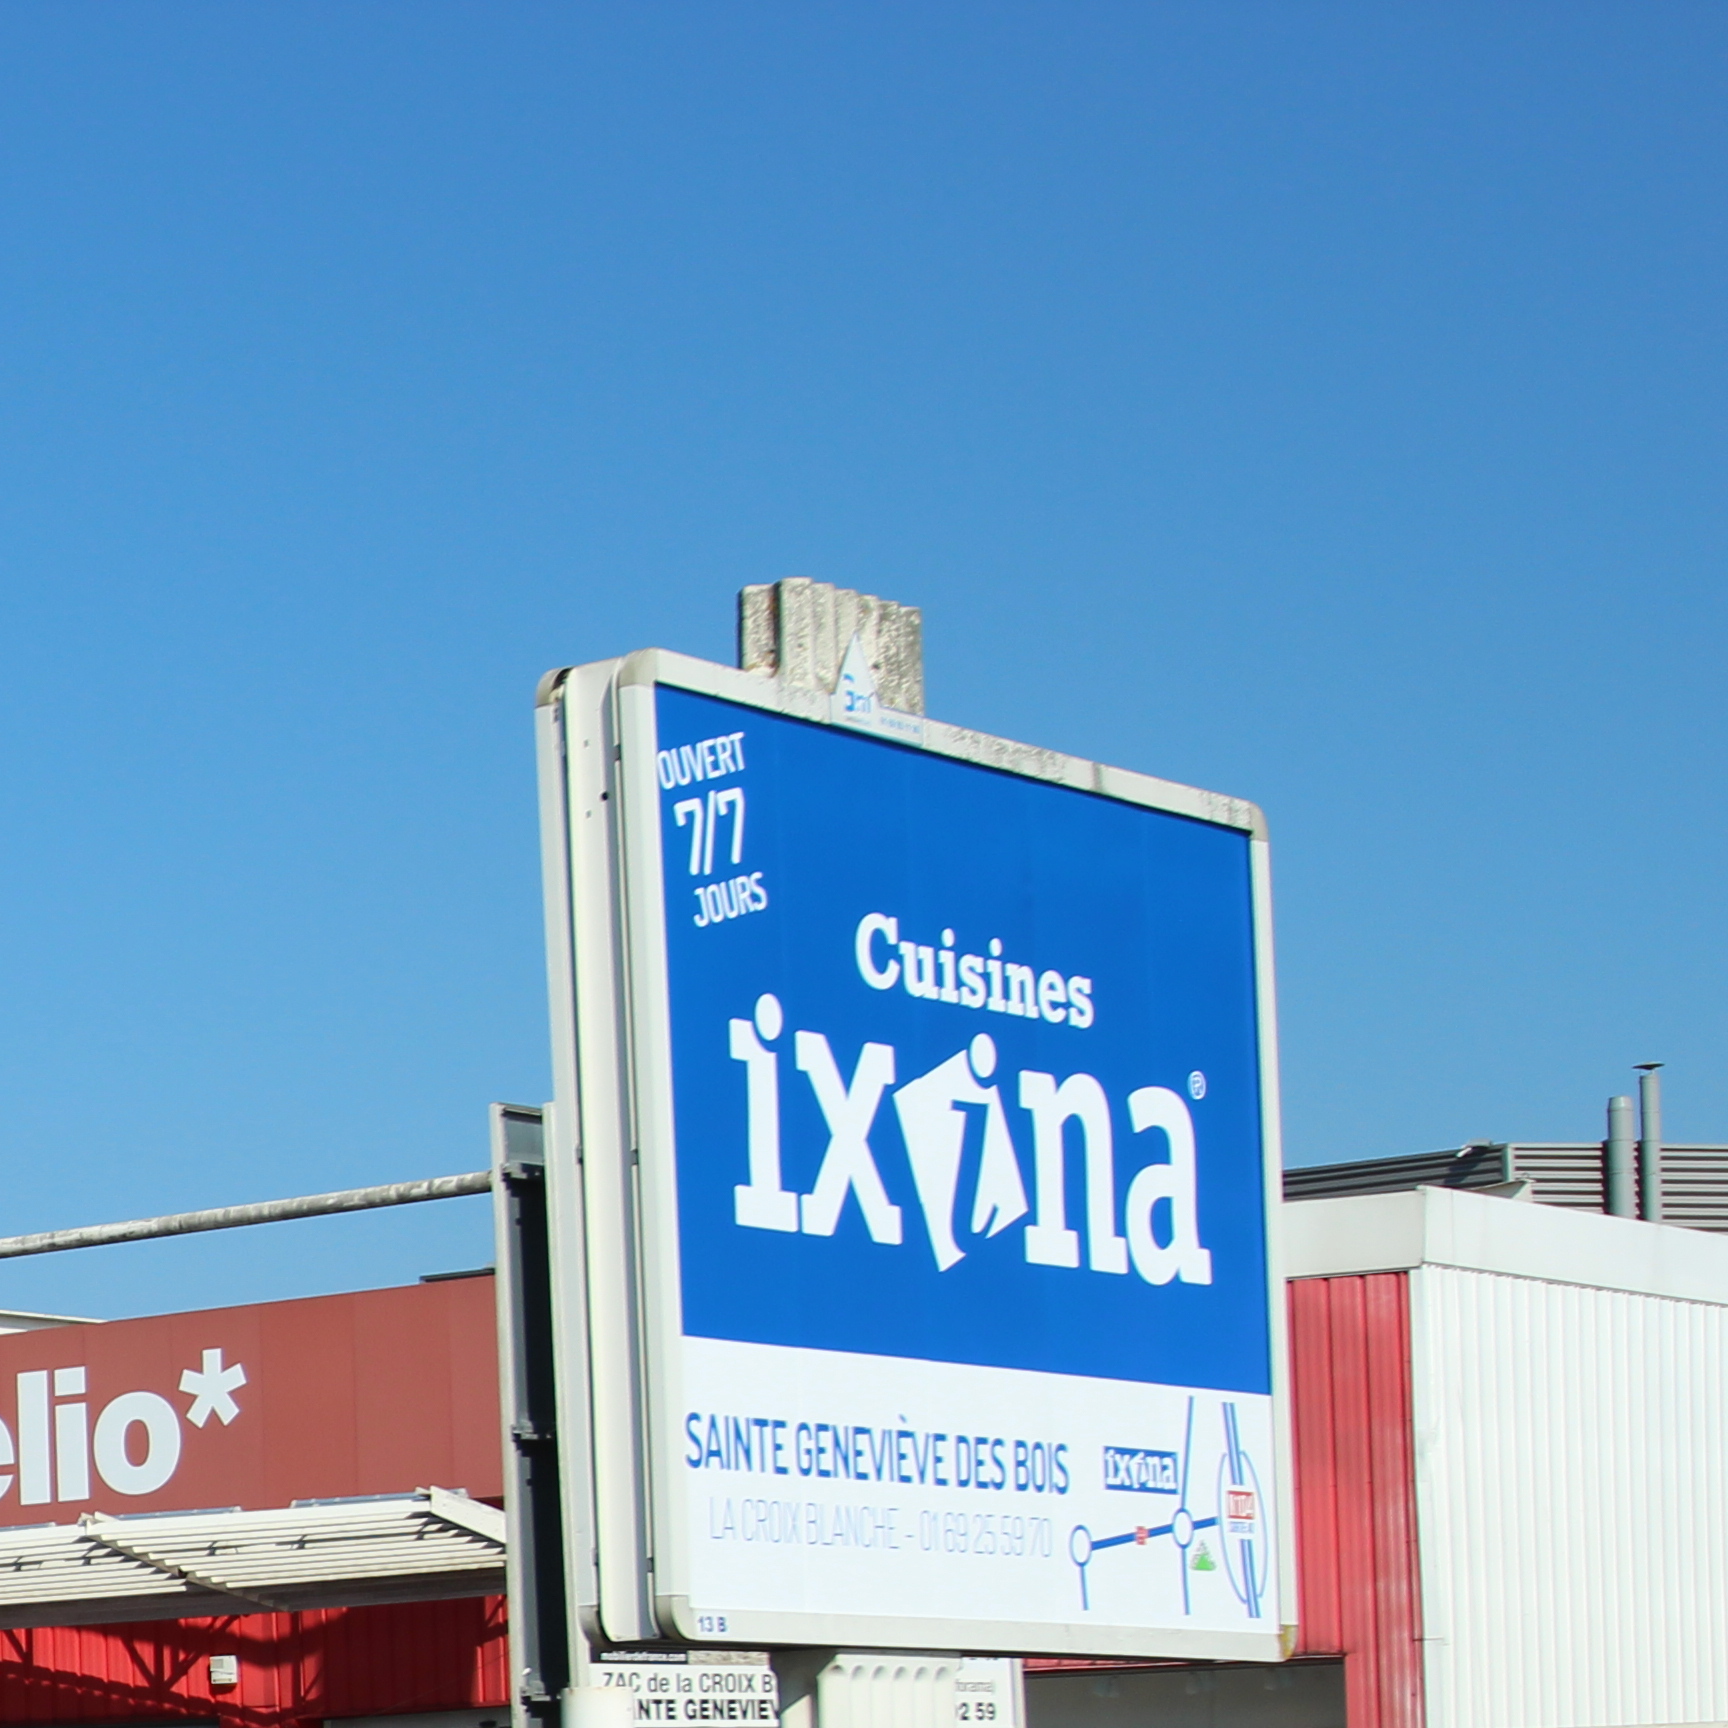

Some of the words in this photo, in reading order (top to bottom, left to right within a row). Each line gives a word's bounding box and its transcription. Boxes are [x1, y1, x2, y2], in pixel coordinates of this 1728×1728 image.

[657, 731, 745, 790] OUVERT
[673, 788, 745, 876] 7/7
[693, 871, 767, 928] JOURS
[854, 912, 1094, 1030] Cuisines
[684, 1411, 789, 1476] SAINTE
[795, 1414, 948, 1487] GENEVIÈVE
[955, 1434, 1006, 1491] DES
[1014, 1439, 1070, 1496] BOIS
[709, 1496, 736, 1540] LA
[742, 1498, 801, 1544] CROIX
[806, 1502, 900, 1549] BLANCHE
[920, 1510, 939, 1551] 01
[944, 1511, 968, 1553] 69
[973, 1513, 997, 1554] 25
[1001, 1515, 1024, 1556] 59
[1029, 1516, 1052, 1557] 70
[697, 1616, 713, 1633] 13
[717, 1616, 727, 1633] B
[602, 1672, 641, 1693] ZAC
[647, 1673, 670, 1693] de
[676, 1673, 693, 1693] la
[698, 1673, 756, 1693] CROIX
[635, 1699, 677, 1720] NTE
[975, 1702, 996, 1721] 59
